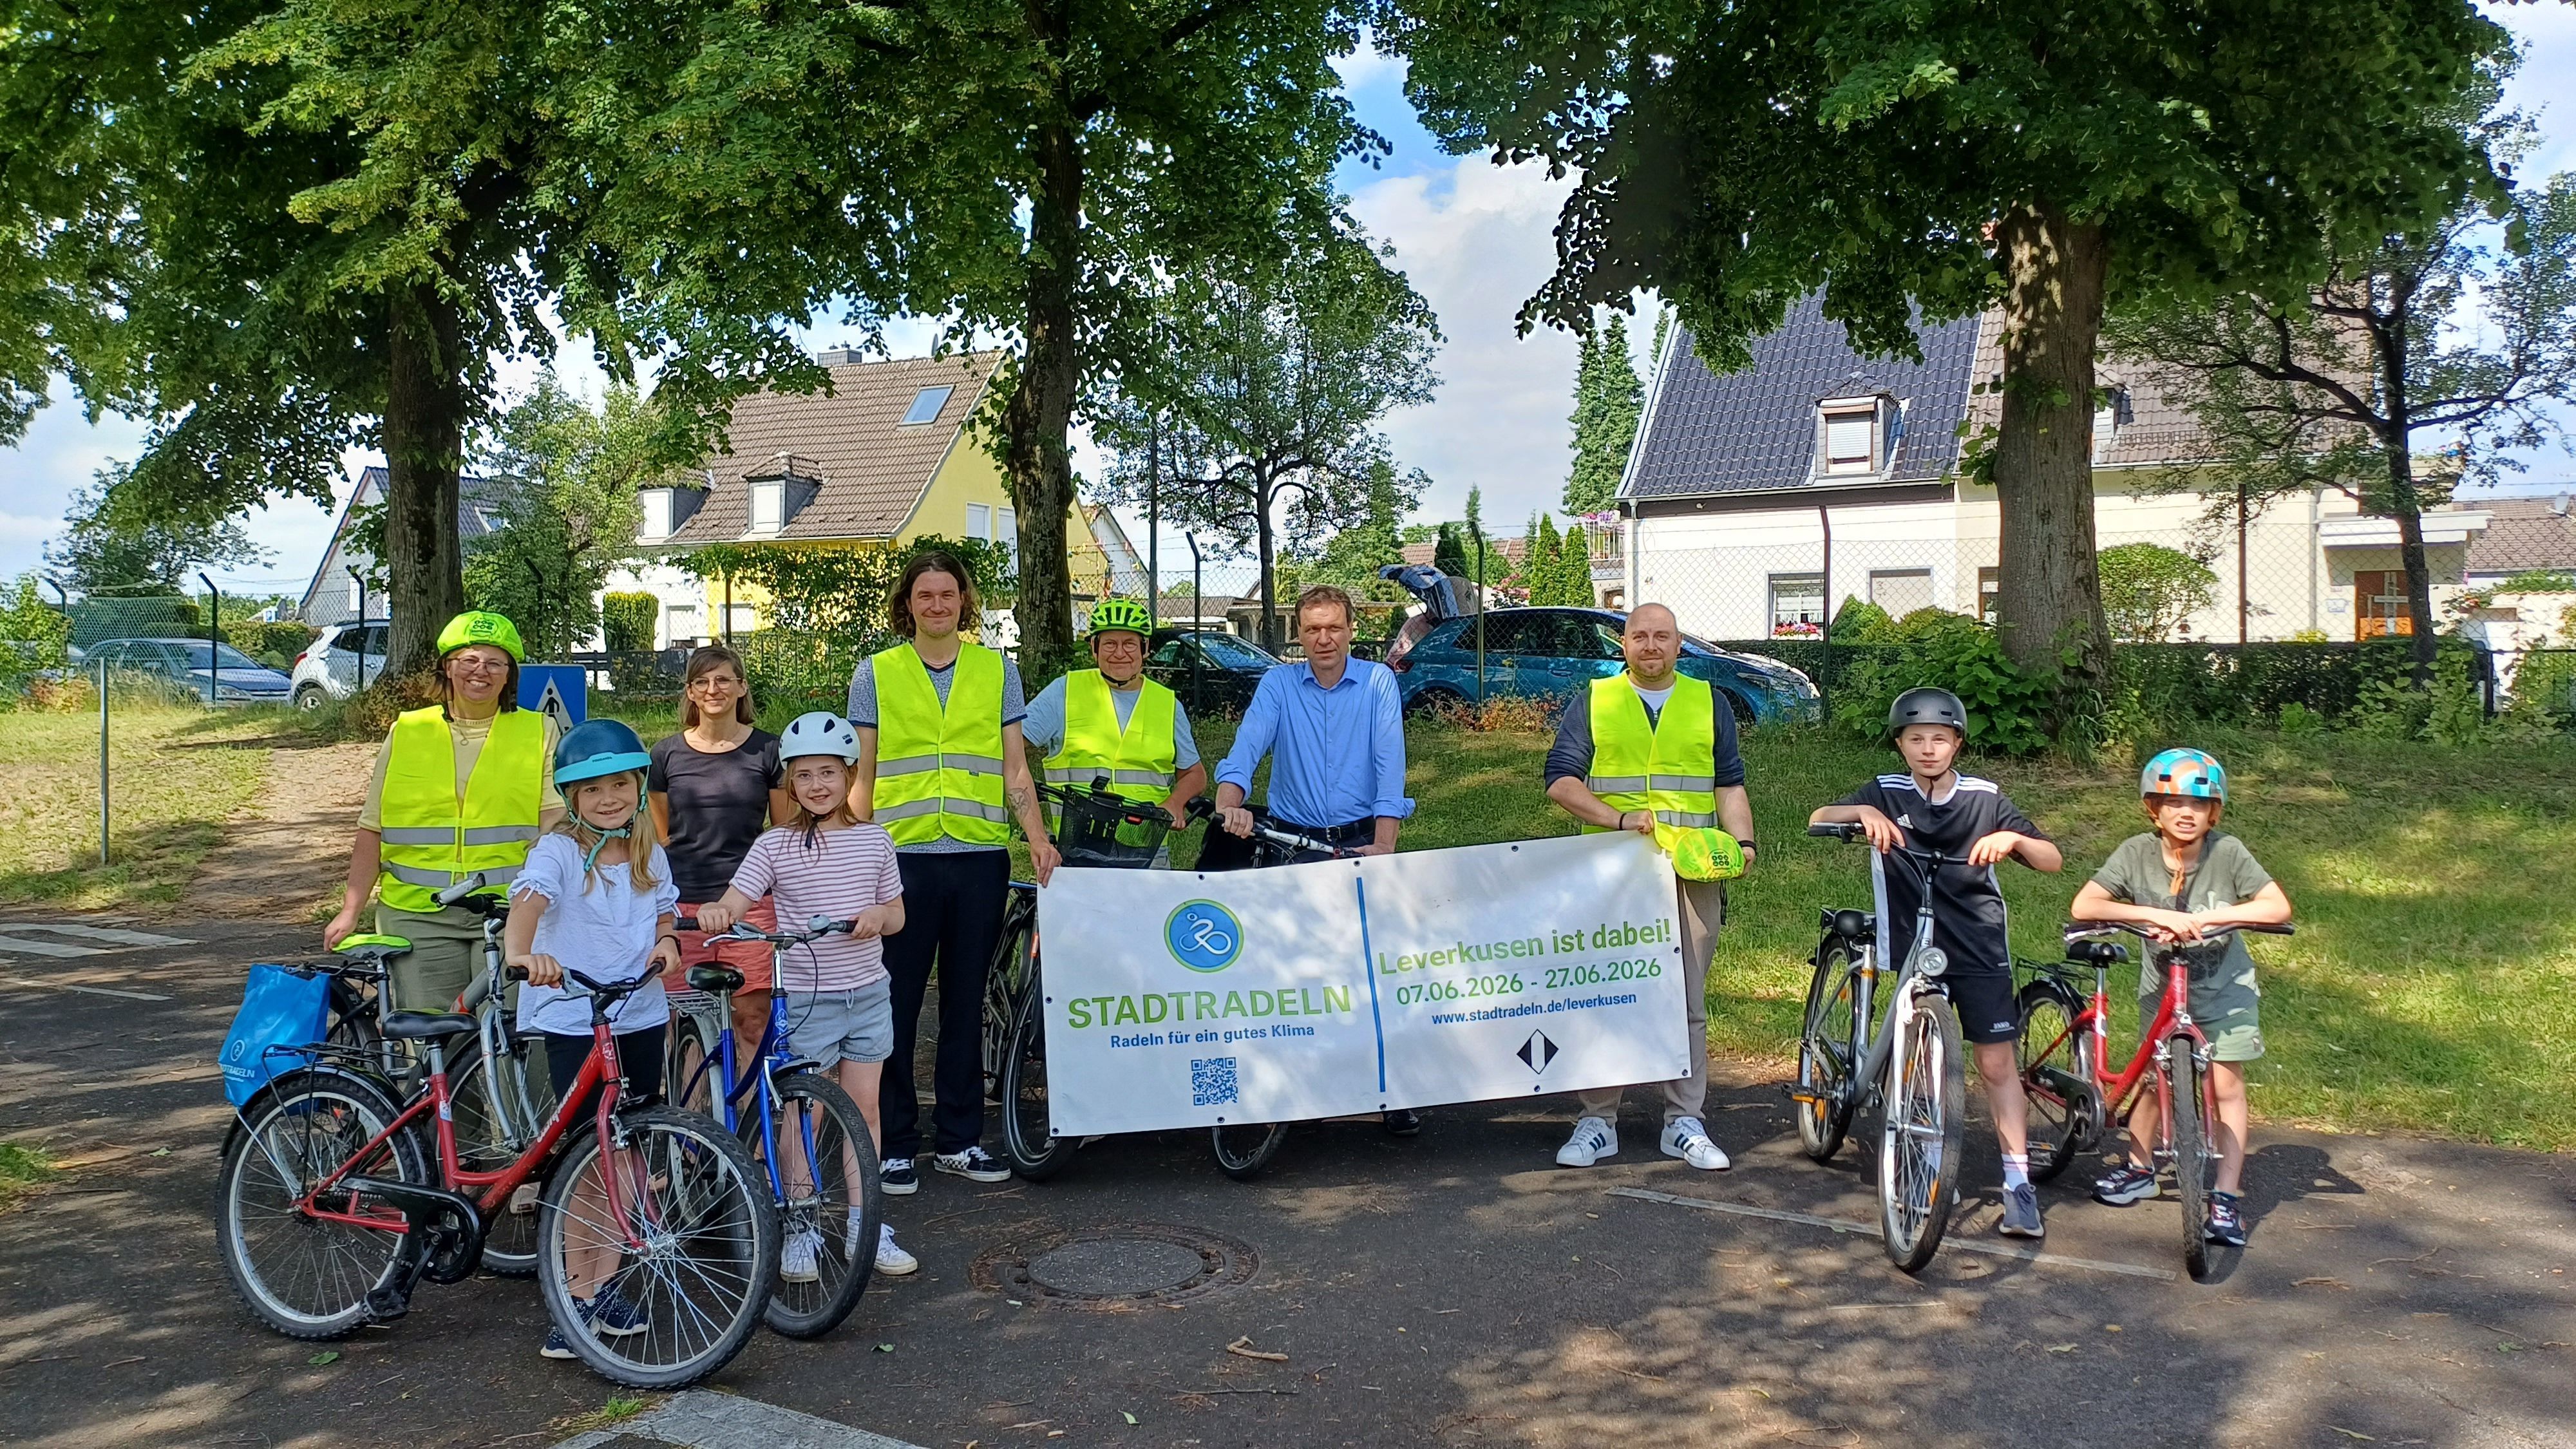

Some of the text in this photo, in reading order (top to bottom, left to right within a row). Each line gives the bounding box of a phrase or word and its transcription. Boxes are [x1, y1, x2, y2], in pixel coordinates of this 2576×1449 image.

[1378, 918, 1672, 975] Leverkusen ist dabei!
[1396, 973, 1524, 1005] 07.06.2026
[1545, 958, 1662, 990] 27.06.2026
[1068, 985, 1351, 1029] STADTRADELN
[1431, 992, 1637, 1025] www.stadtradeln.de/leverkusen
[1110, 1024, 1315, 1048] Radeln für ein gutes Klima
